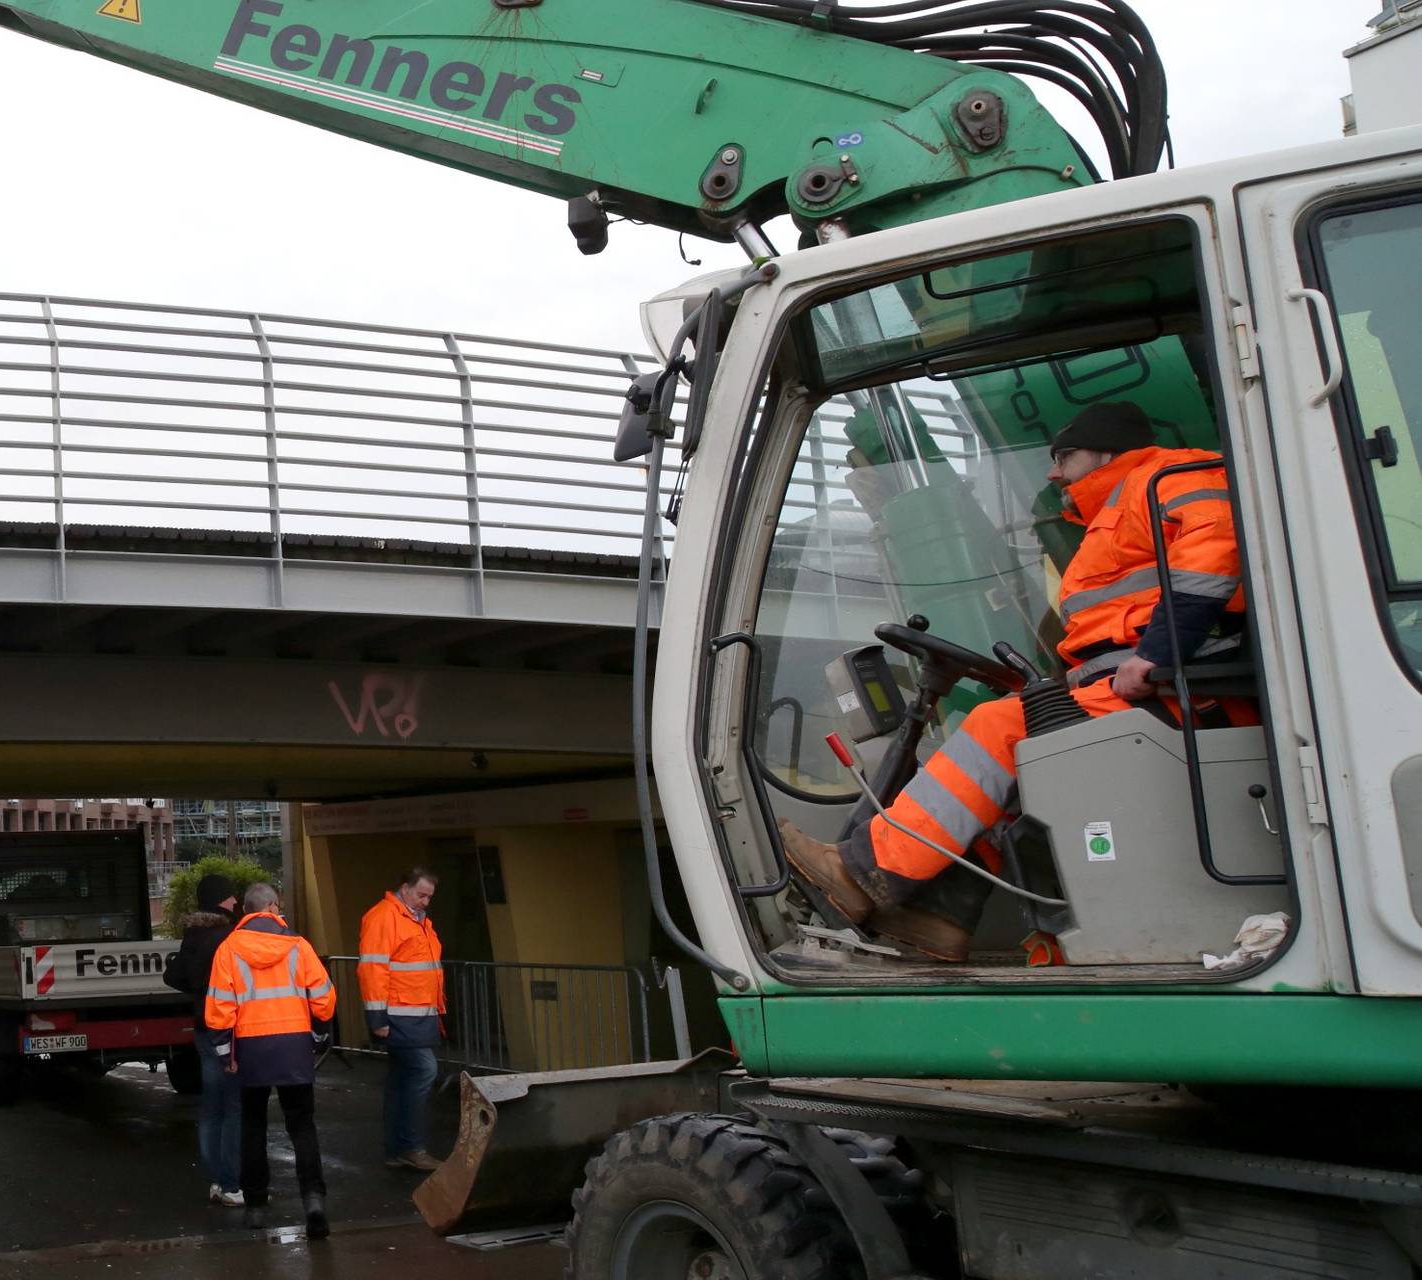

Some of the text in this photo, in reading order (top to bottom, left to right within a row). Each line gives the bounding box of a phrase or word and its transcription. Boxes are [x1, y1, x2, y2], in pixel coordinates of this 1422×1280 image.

[219, 0, 582, 136] Fenners
[30, 1035, 87, 1049] WES WF 900
